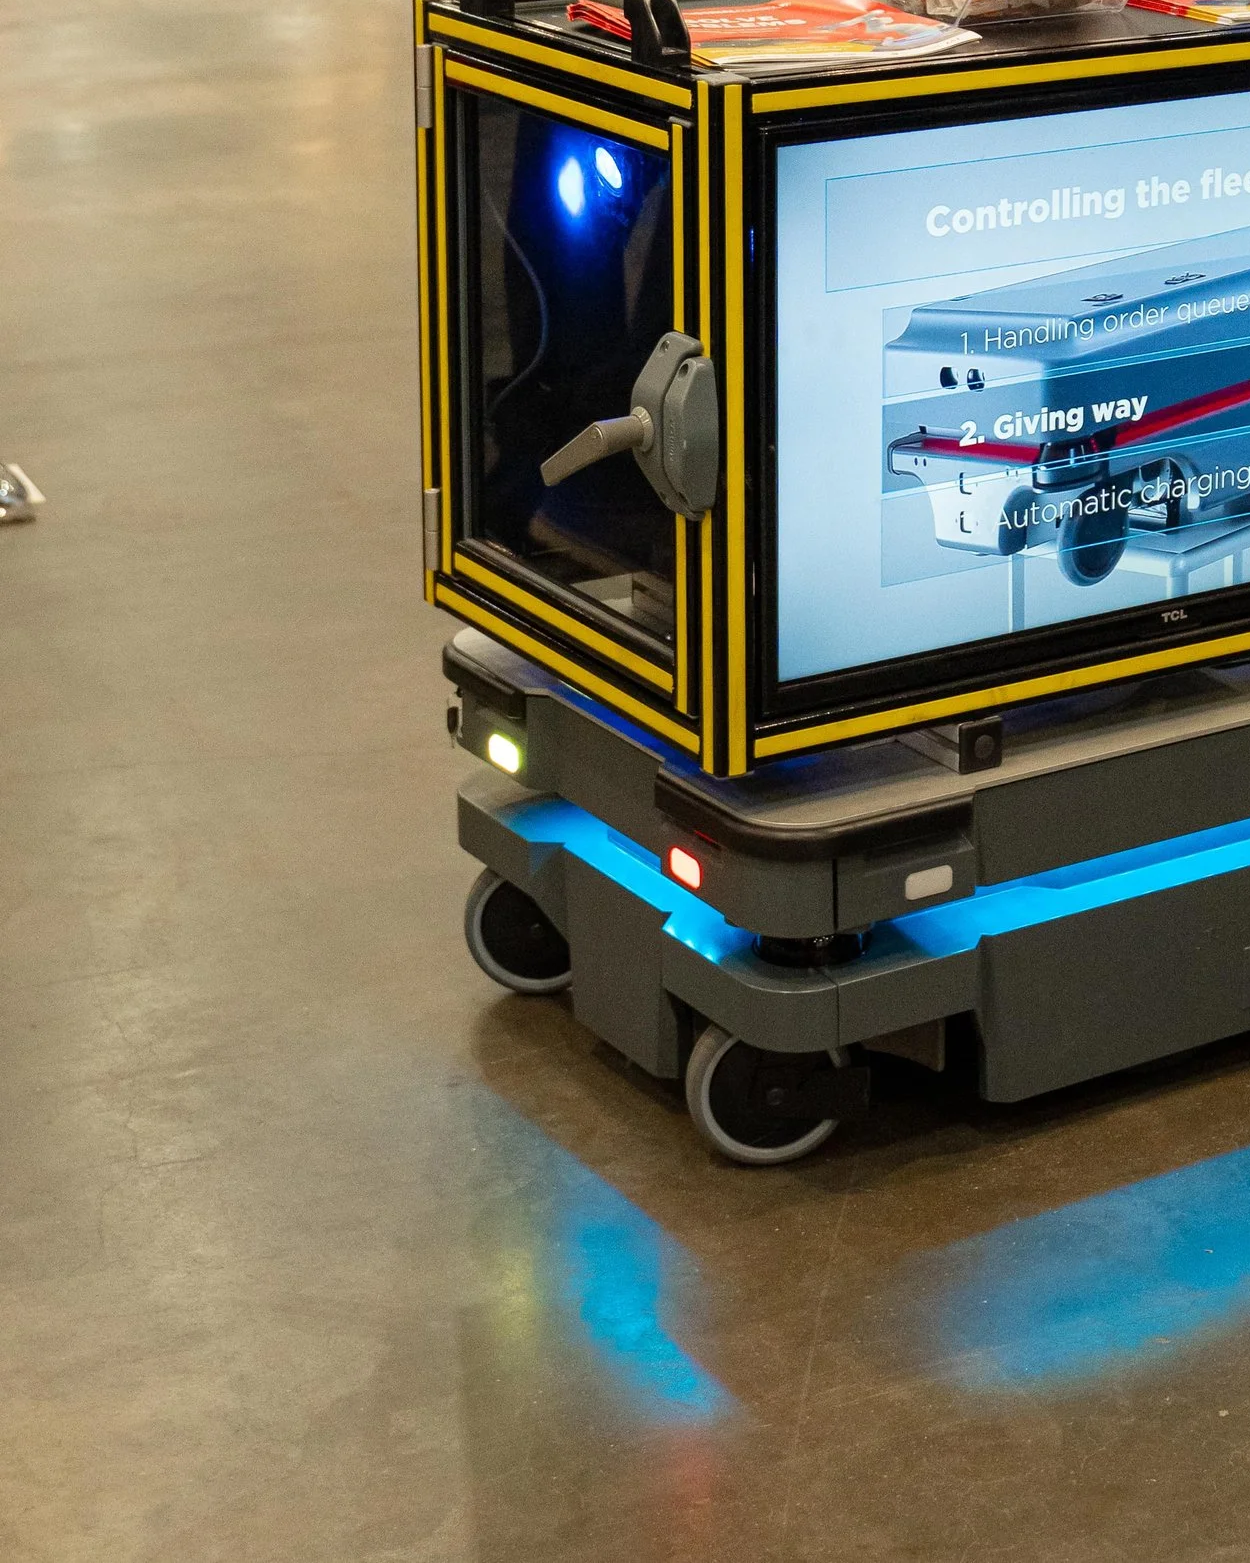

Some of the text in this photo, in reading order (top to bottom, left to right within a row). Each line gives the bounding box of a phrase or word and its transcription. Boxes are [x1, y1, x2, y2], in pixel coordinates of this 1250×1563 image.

[926, 186, 1126, 238] Controlling
[1136, 176, 1191, 208] the
[960, 331, 975, 355] 1.
[984, 314, 1095, 352] Handling
[1103, 303, 1169, 333] order
[959, 395, 1149, 448] 2. Giving way
[993, 484, 1133, 532] Automatic
[1161, 609, 1188, 623] TCL
